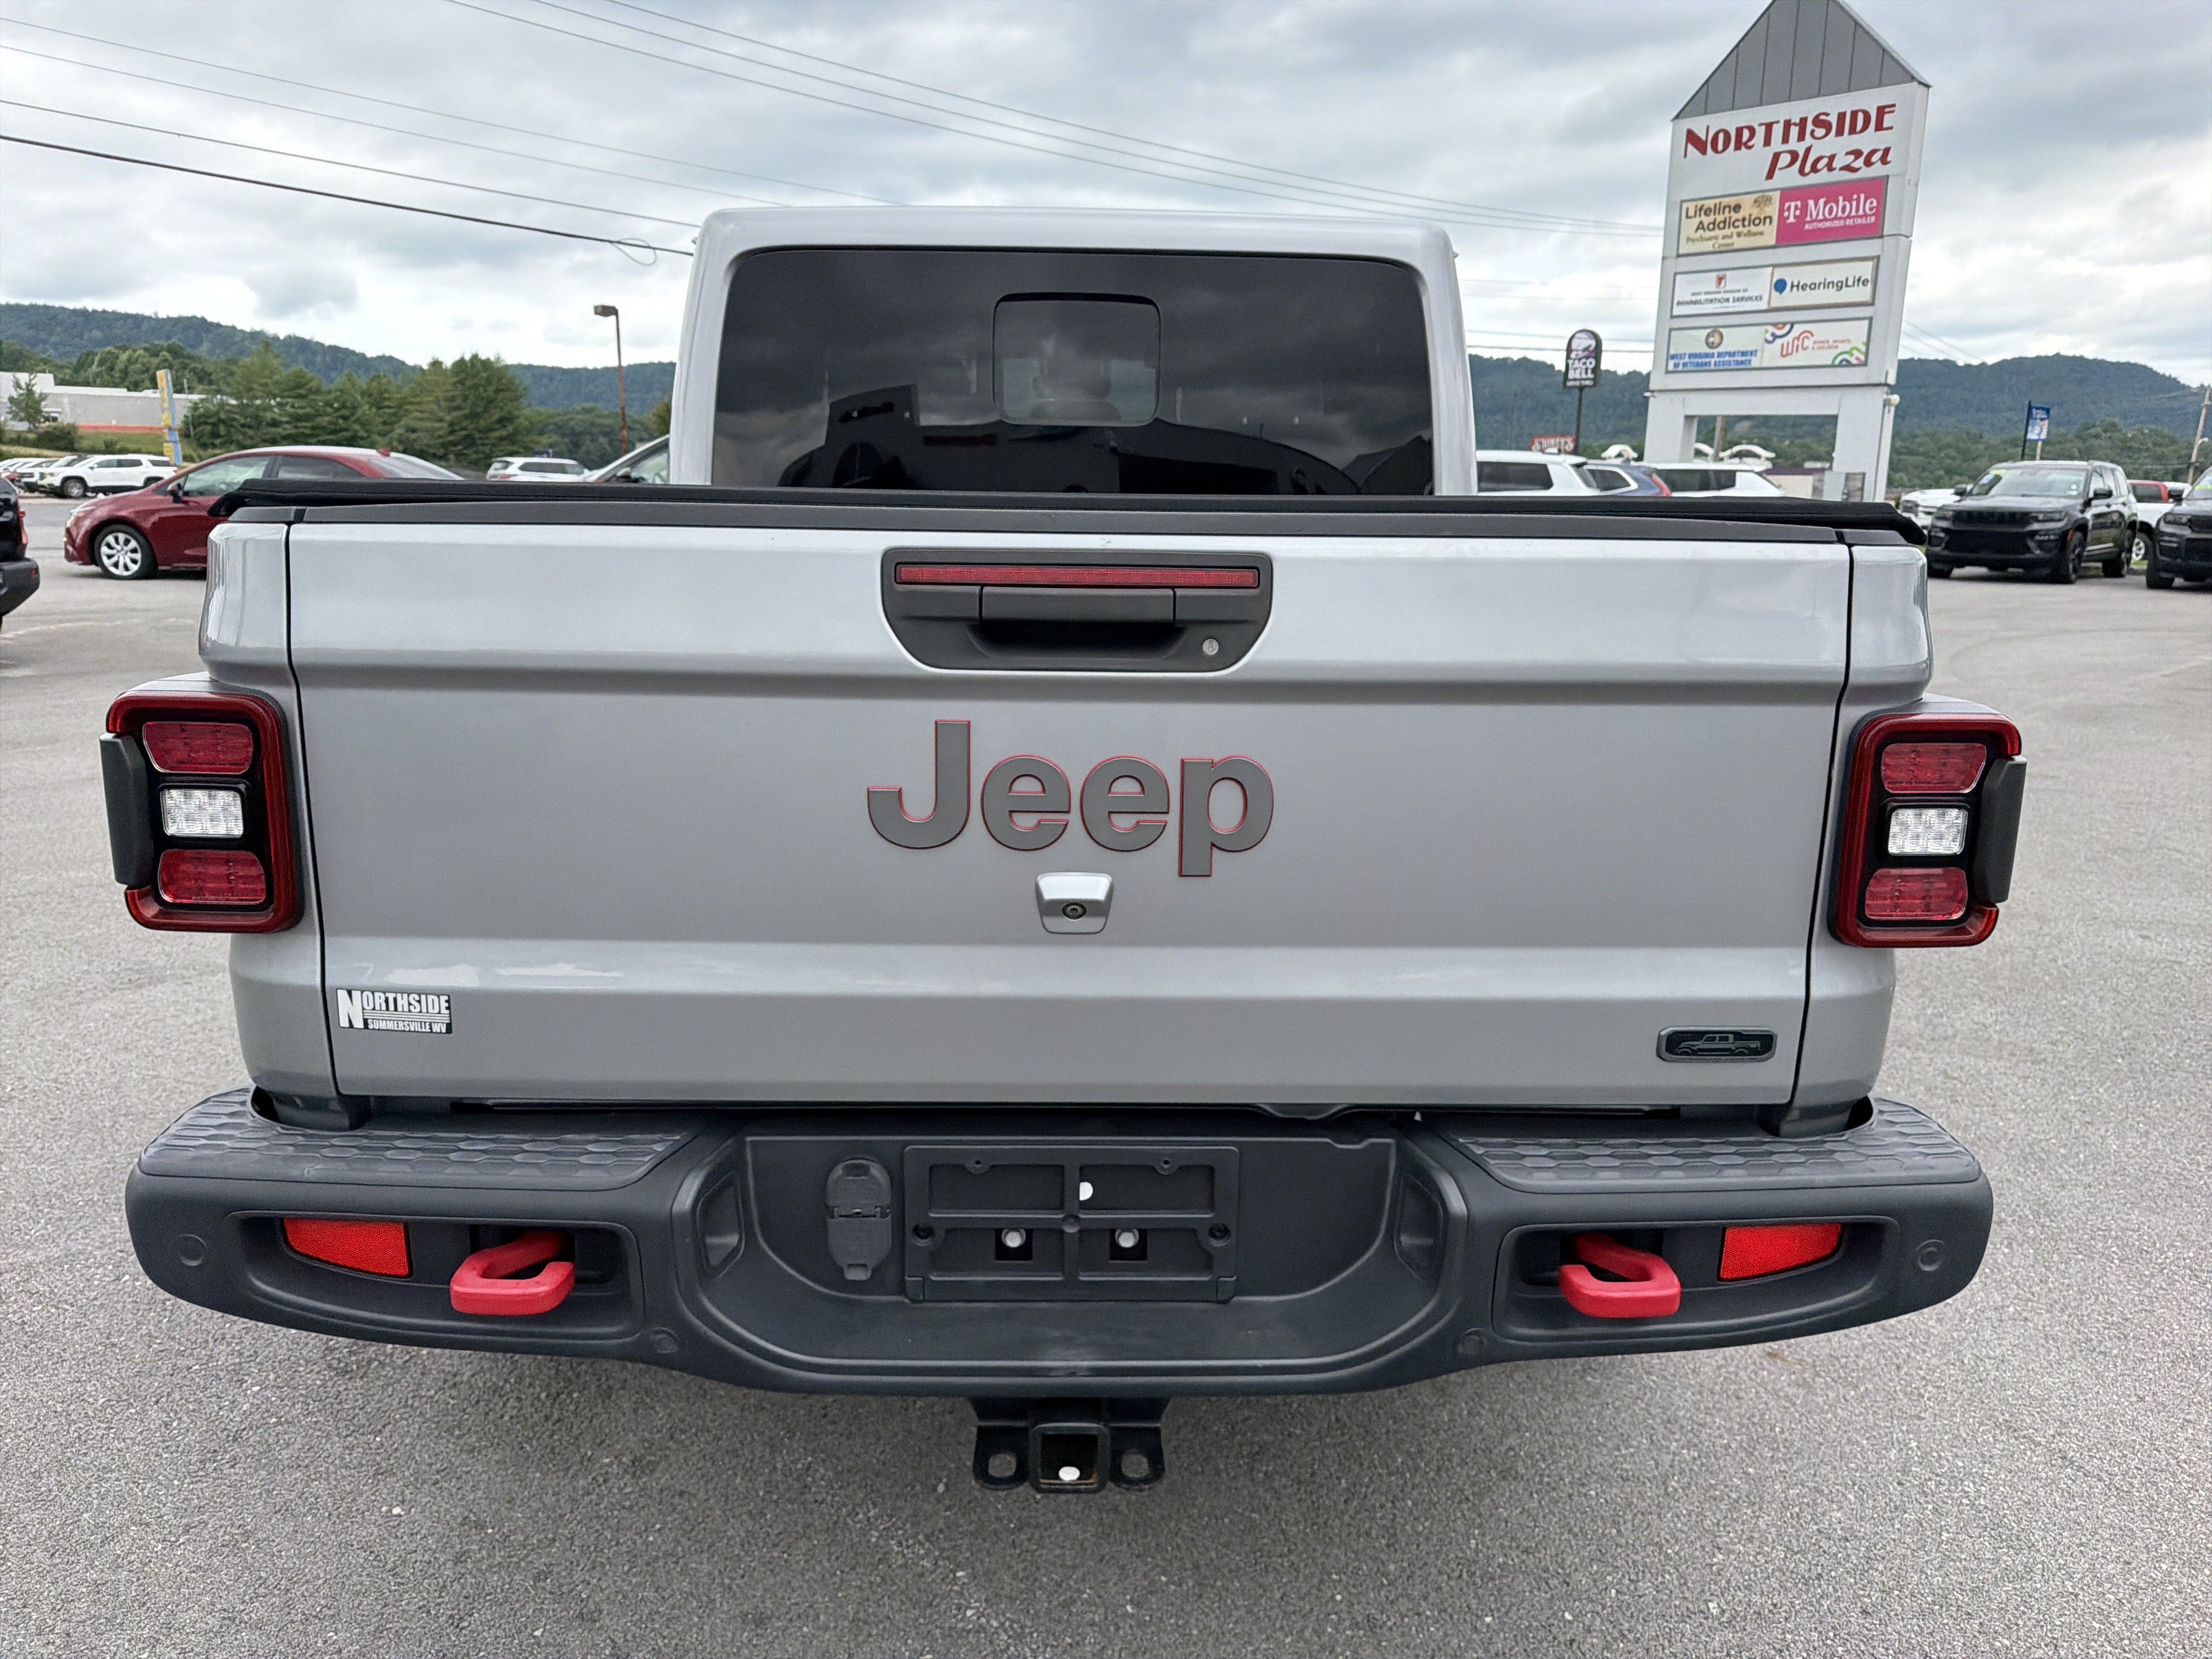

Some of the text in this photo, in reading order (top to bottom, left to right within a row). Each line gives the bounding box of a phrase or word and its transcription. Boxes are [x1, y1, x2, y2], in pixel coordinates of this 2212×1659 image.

[1683, 103, 1897, 159] NORTHSIDE
[1764, 144, 1892, 181] Plaza
[1685, 201, 1742, 219] Lifeline
[1805, 193, 1877, 221] Mobile
[1695, 213, 1773, 233] Addiction
[1790, 275, 1870, 292] HearingLife
[1567, 358, 1595, 368] TACO
[867, 719, 1274, 877] Jeep
[337, 989, 450, 1029] NORTHSIDE
[368, 1019, 447, 1033] SUMMERSVILLE WV
